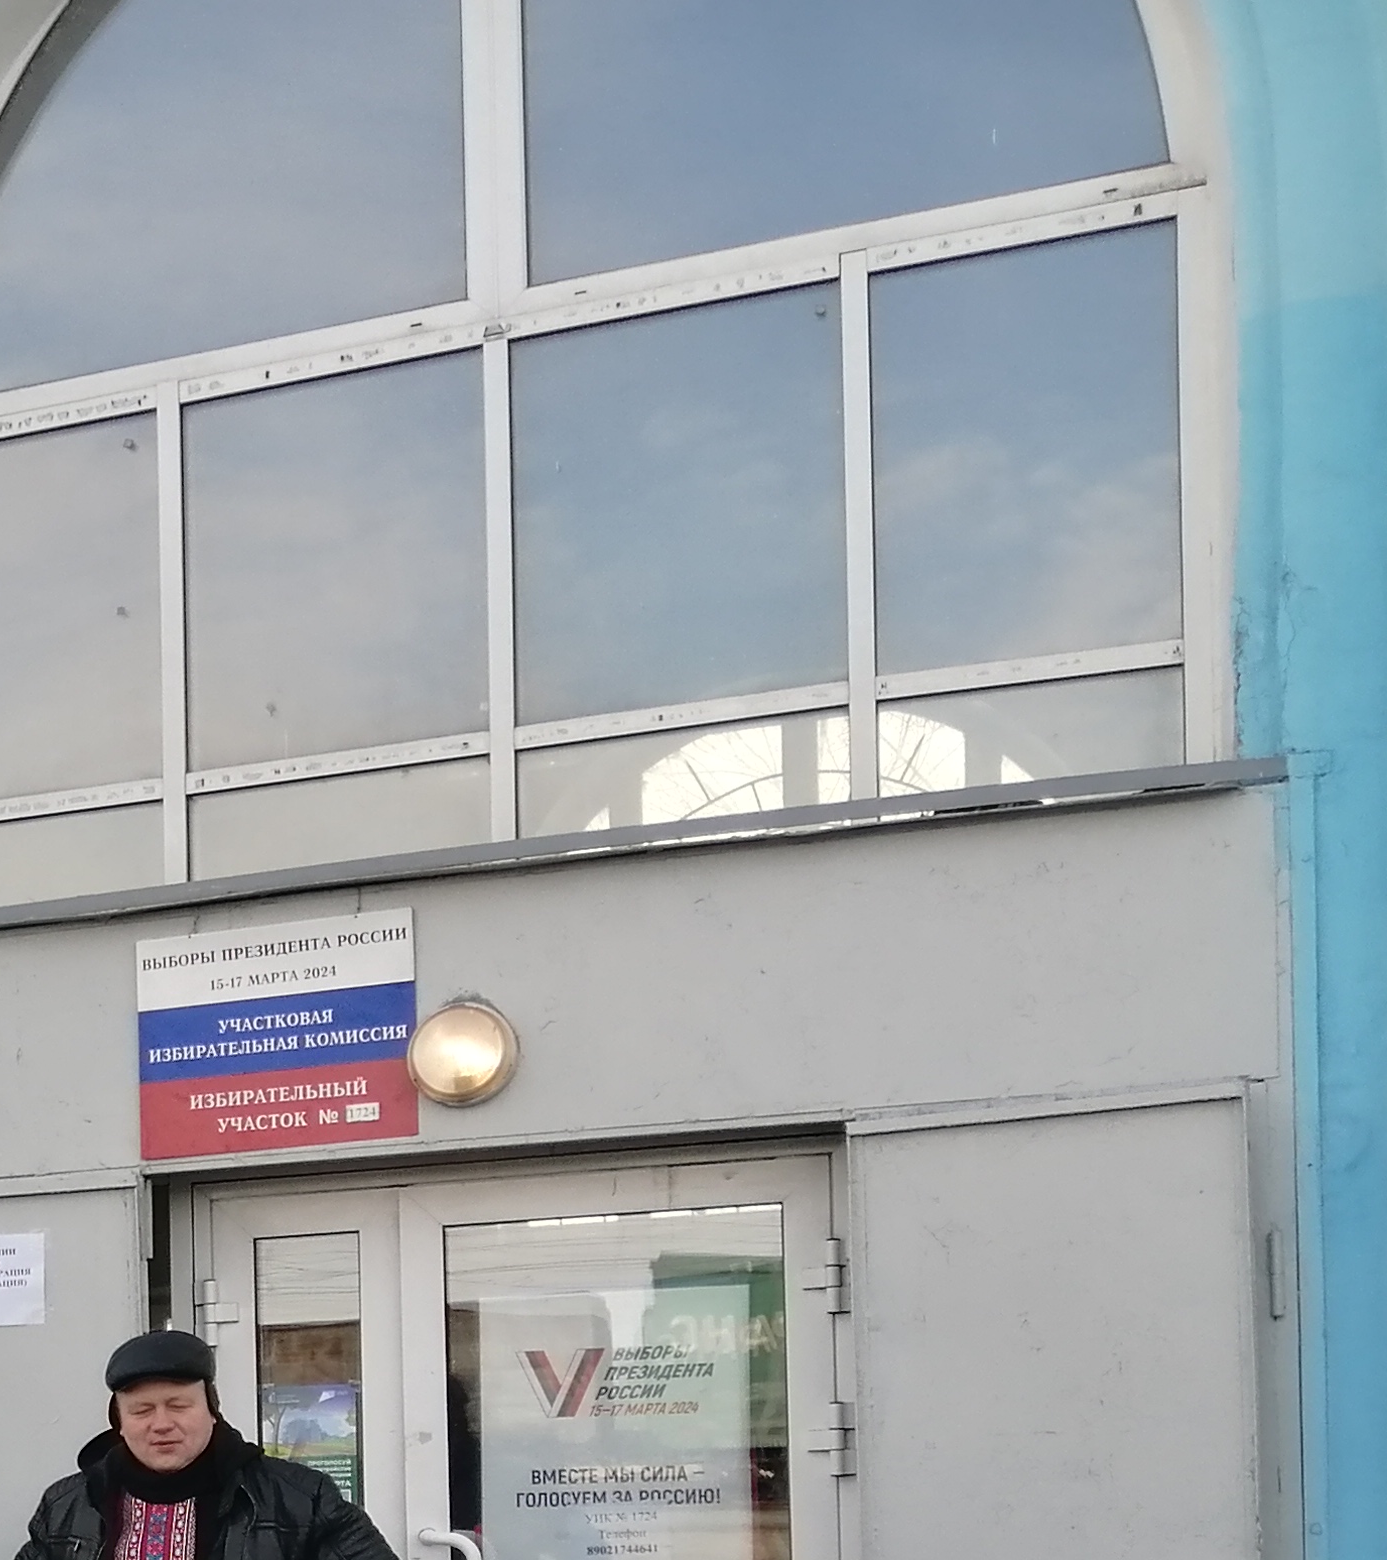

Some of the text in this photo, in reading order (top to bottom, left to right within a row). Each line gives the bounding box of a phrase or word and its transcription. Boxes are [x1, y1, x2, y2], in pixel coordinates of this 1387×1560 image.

[142, 927, 408, 972] ВЫБОРЫ ПРЕЗИДЕНТА РОССИИ
[210, 965, 337, 991] 15-17 МАРТА 2024
[218, 1009, 334, 1034] УЧАСТКОВАЯ
[148, 1024, 409, 1064] ИЗБИРАТЕЛЬНАЯ КОМИССИЯ
[190, 1078, 368, 1110] ИЗБИРАТЕЛЬНЫЙ
[217, 1106, 376, 1134] УЧАСТОК № 1724
[613, 1345, 690, 1361] ВЫБОРЫ
[604, 1362, 714, 1381] ПРЕЗИДЕНТА
[595, 1384, 667, 1400] РОССИИ
[624, 1402, 667, 1416] МАРТА
[668, 1401, 699, 1415] 2024
[531, 1468, 599, 1485] ВМЕСТЕ
[604, 1466, 635, 1483] МЫ
[640, 1465, 688, 1482] СИЛА
[516, 1488, 721, 1508] ГОЛОСУЕМ ЗА РОССИЮ!
[598, 1529, 647, 1540] Телефон
